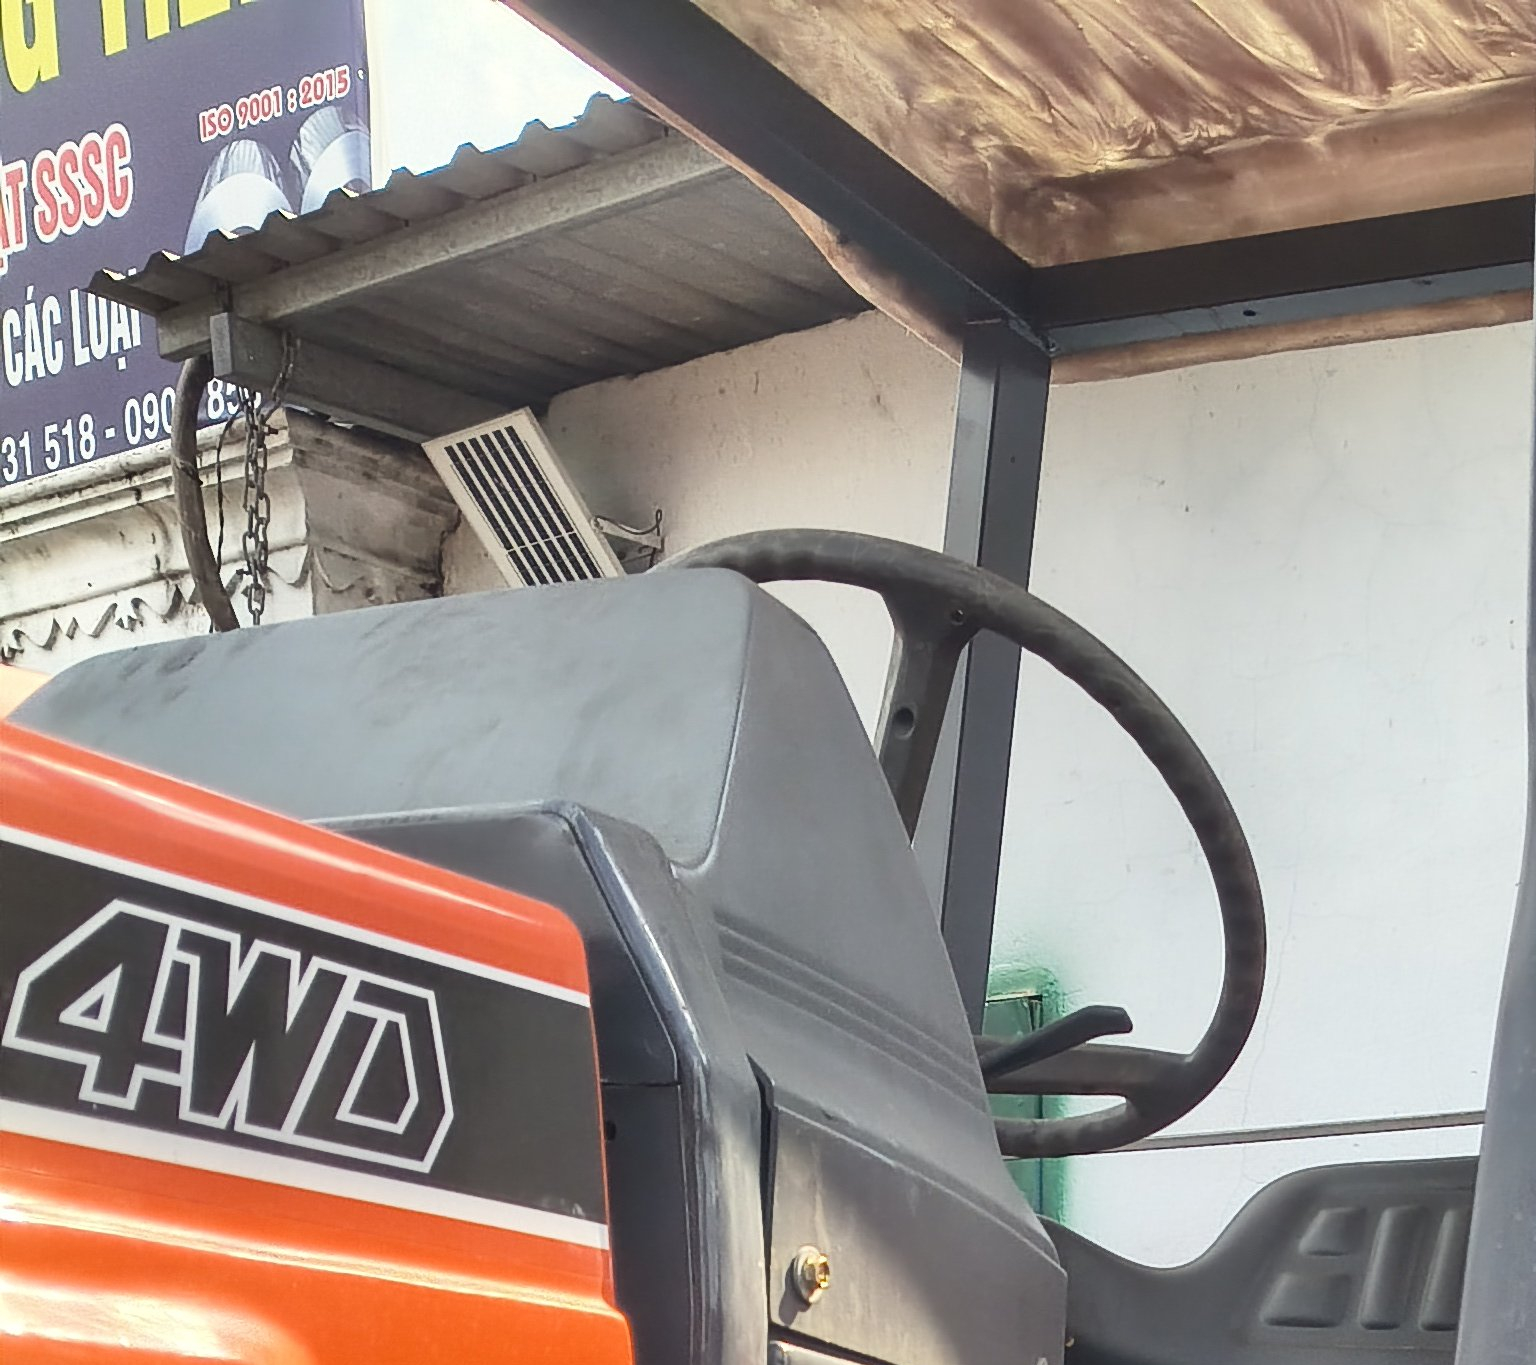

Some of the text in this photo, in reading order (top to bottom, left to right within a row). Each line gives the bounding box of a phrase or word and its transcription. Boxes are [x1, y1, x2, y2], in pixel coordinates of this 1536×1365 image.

[199, 104, 234, 143] ISO
[236, 86, 283, 130] 9001
[299, 65, 350, 109] 2015
[32, 123, 133, 243] SSSC
[3, 285, 64, 387] CÁC
[44, 413, 96, 470] 518
[2, 898, 454, 1173] 4WD
